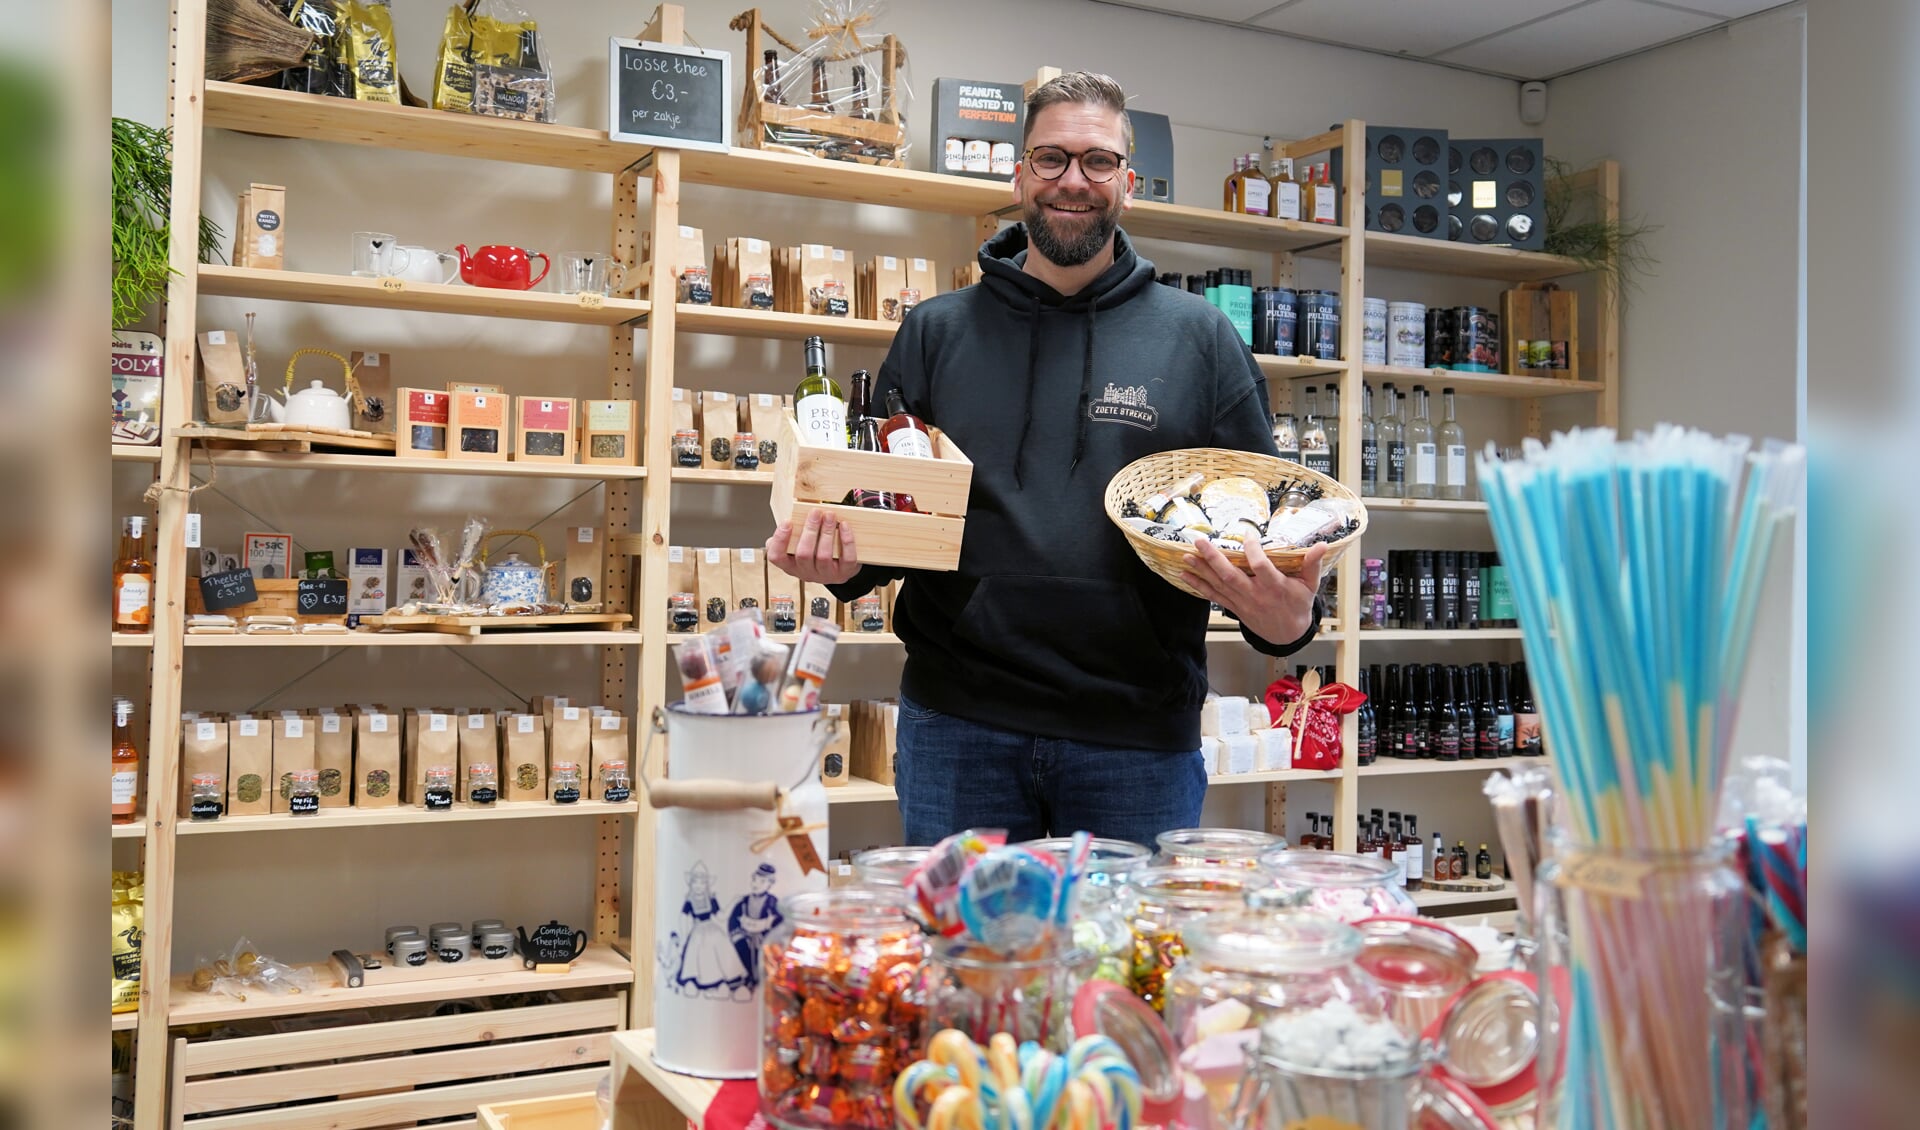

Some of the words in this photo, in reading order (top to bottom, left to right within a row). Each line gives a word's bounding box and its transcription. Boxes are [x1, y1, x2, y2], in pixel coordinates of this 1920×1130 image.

[625, 53, 669, 73] Losse
[673, 57, 708, 77] thee
[959, 97, 1001, 110] ROASTED
[1002, 101, 1016, 112] TO
[632, 109, 649, 123] per
[653, 111, 682, 130] zakje
[1277, 303, 1292, 311] OLD
[1319, 306, 1333, 314] OLD
[1274, 340, 1294, 349] FUDGE
[1315, 342, 1335, 351] FUDGE
[811, 408, 840, 420] PRO
[1095, 405, 1120, 416] ZOETE
[1119, 407, 1153, 423] STREKEN
[811, 421, 840, 433] OST
[254, 540, 284, 550] t-sac
[249, 549, 265, 558] 100
